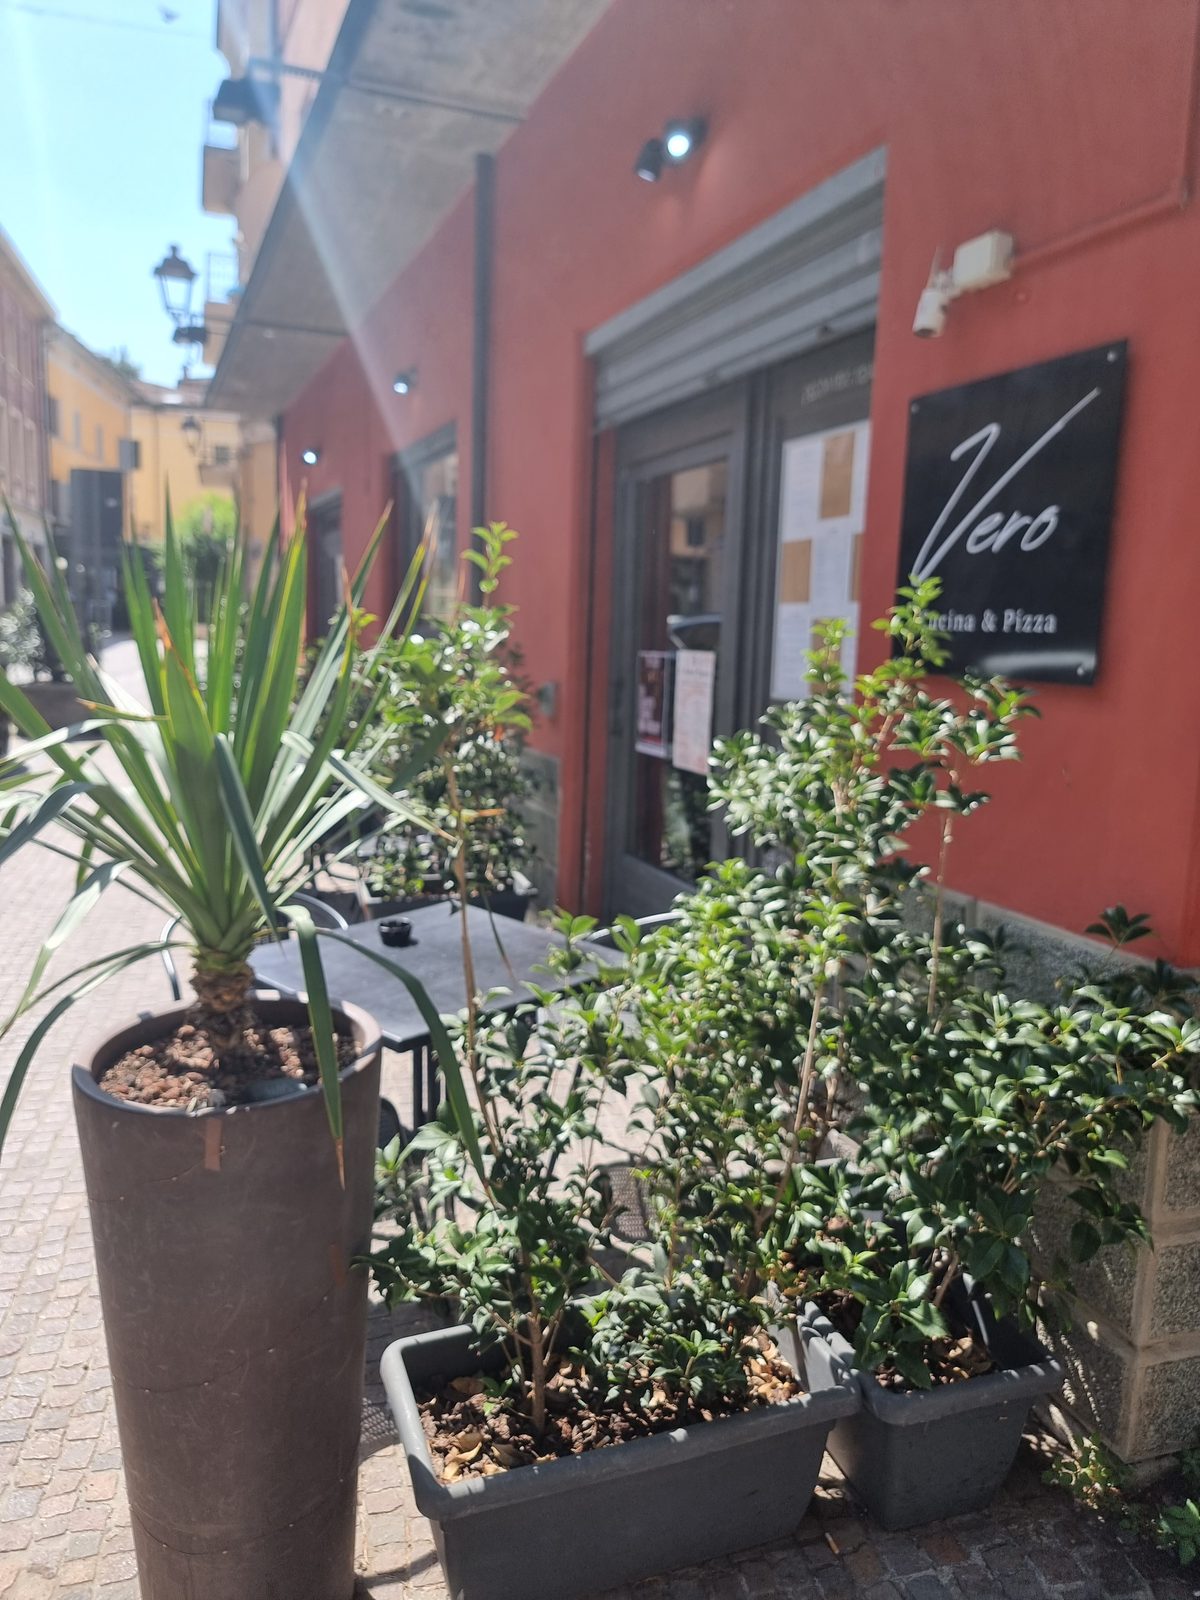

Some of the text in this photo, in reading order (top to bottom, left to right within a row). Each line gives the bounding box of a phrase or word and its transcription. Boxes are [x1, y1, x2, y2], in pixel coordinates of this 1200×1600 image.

[911, 387, 1100, 586] Vero
[922, 608, 1058, 633] ucina & Pizza
